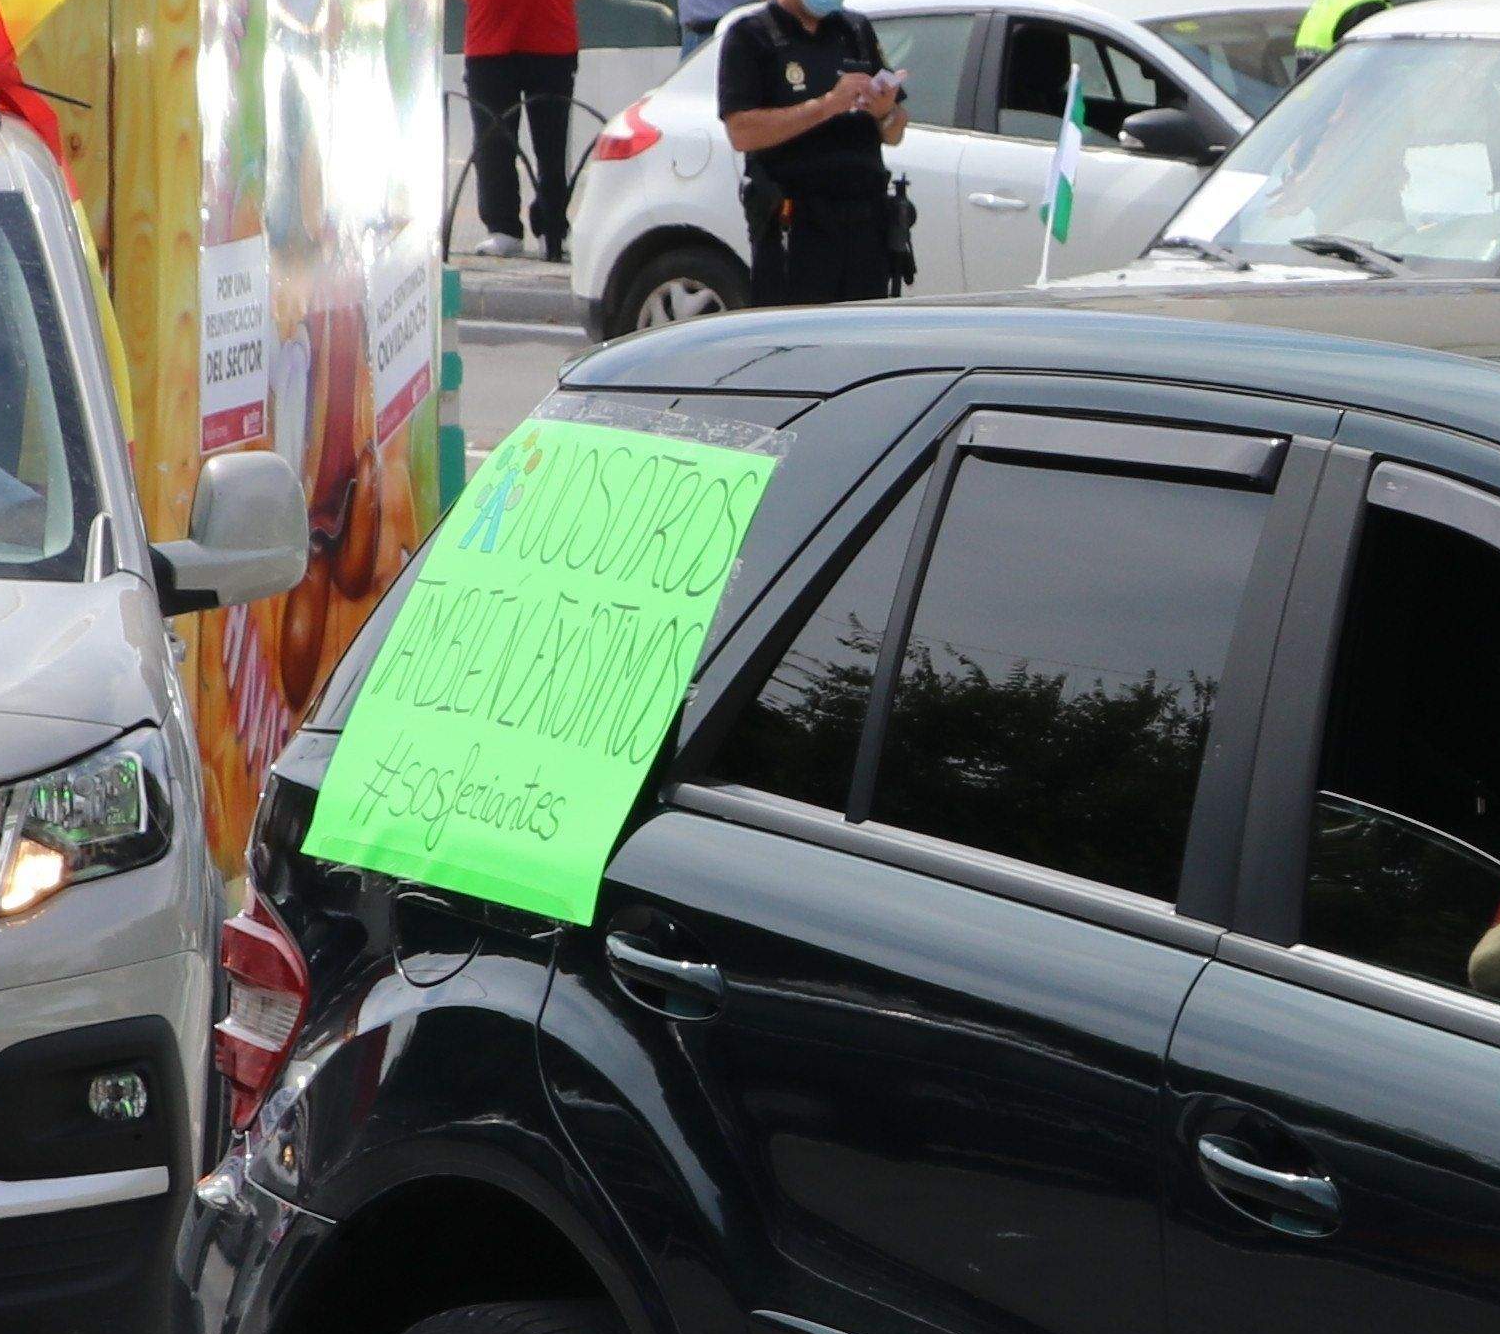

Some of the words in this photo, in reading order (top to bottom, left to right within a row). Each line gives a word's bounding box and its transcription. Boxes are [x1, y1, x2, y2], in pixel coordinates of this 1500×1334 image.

[216, 274, 233, 301] POR
[234, 269, 252, 298] UNA
[206, 349, 223, 385] DEL
[226, 339, 263, 380] SECTOR
[377, 294, 427, 372] OLVIDADOS
[501, 441, 758, 598] NOSOTROS
